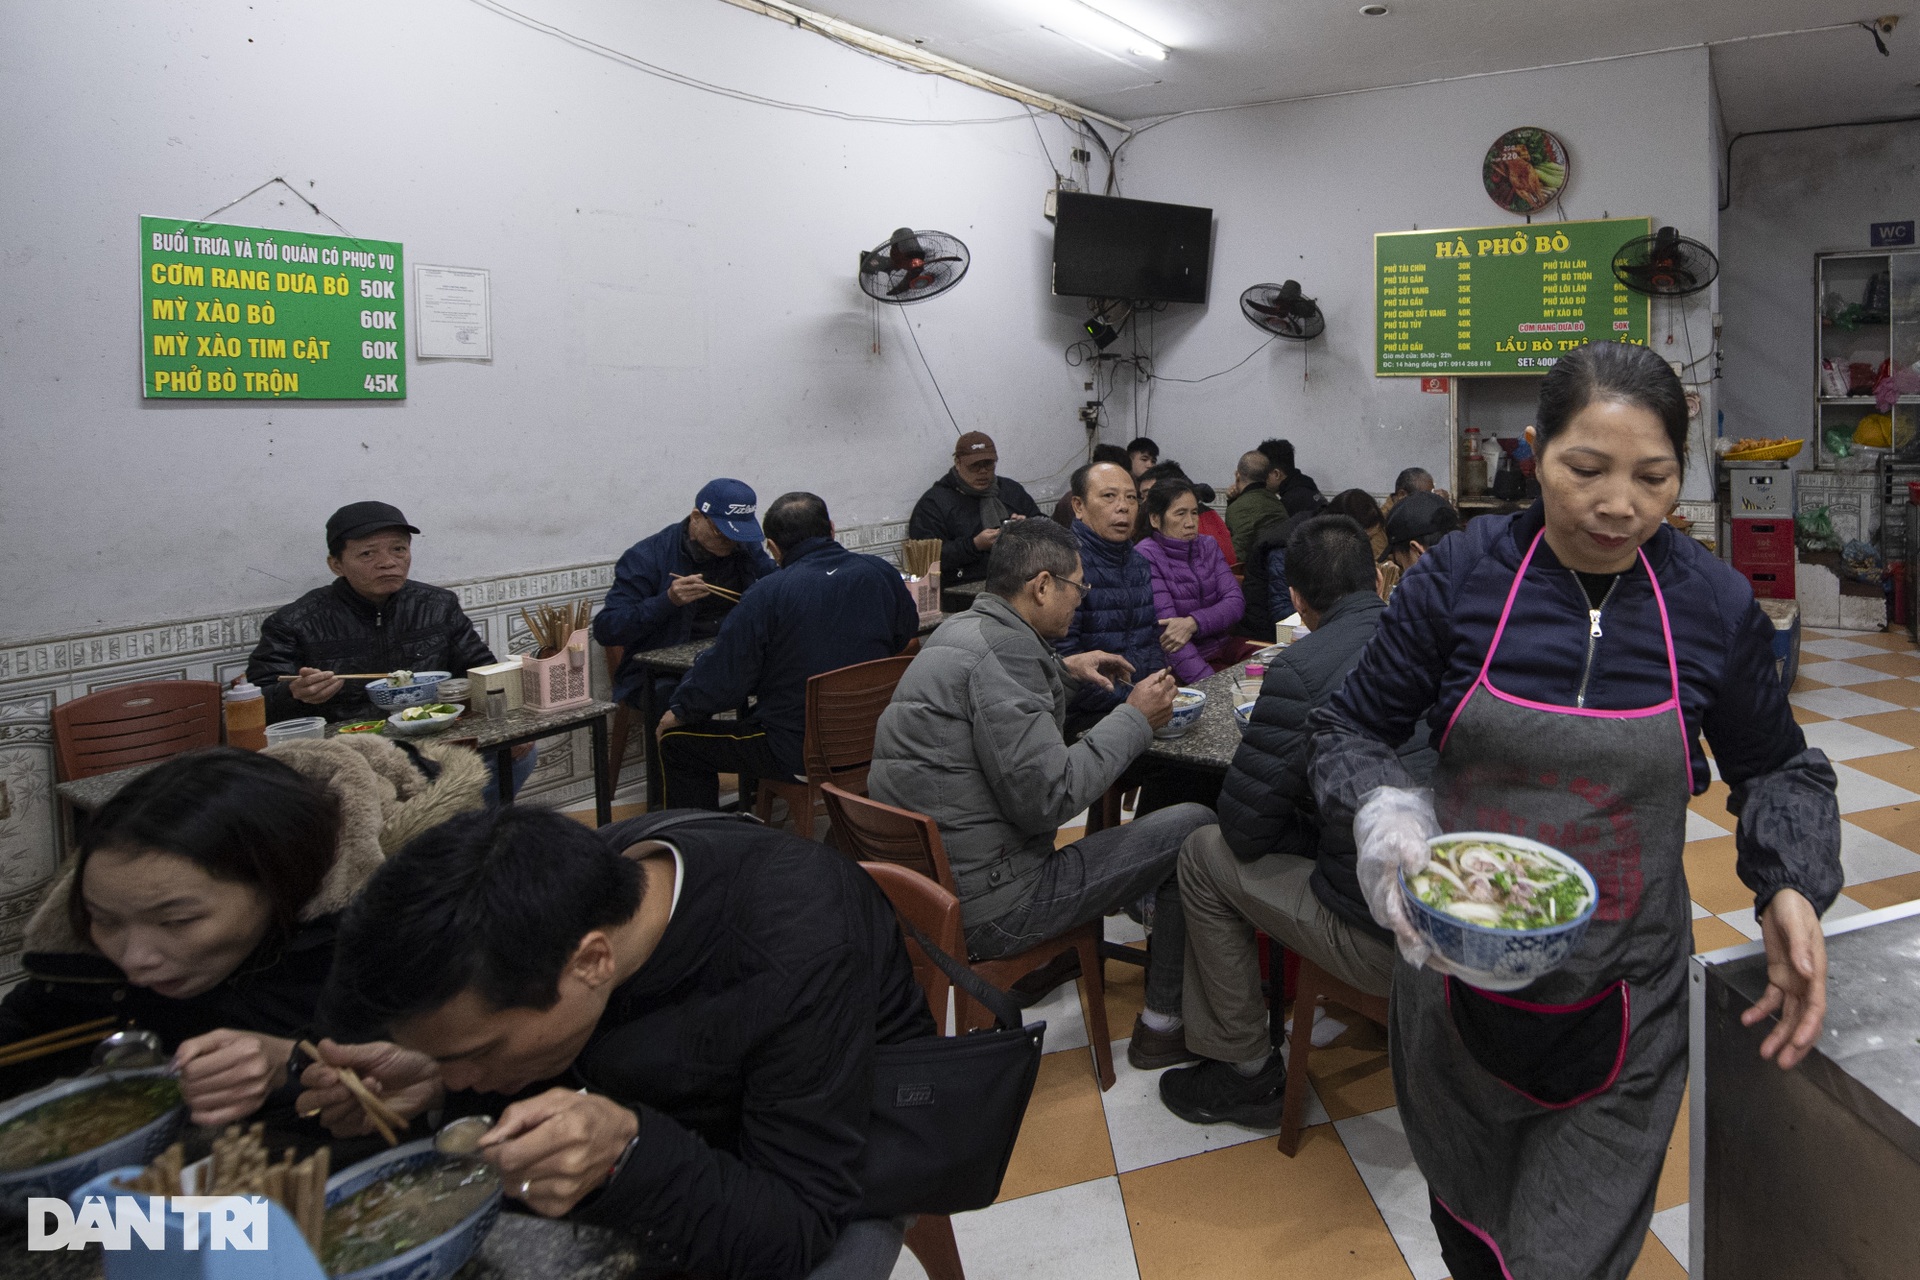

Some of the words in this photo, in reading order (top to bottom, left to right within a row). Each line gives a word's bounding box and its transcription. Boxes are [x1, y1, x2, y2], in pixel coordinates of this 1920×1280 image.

[1880, 226, 1906, 238] WC
[1436, 236, 1471, 258] HÀ
[1477, 231, 1529, 256] PHỞ
[1535, 230, 1571, 254] BÒ
[152, 228, 189, 253] BUỔI
[192, 236, 231, 256] TRƯA
[234, 237, 253, 258] VÀ
[256, 238, 278, 261] TỐI
[281, 246, 318, 264] QUÁN
[322, 246, 338, 266] CÓ
[342, 251, 375, 272] PHỤC
[379, 254, 394, 273] VỤ
[1384, 264, 1397, 273] PHỞ
[1543, 261, 1558, 270] PHỞ
[1560, 261, 1570, 269] TÁI
[151, 263, 204, 286] CƠM
[211, 269, 269, 291] RANG
[276, 272, 318, 294] DƯA
[323, 272, 350, 296] BÒ
[360, 280, 396, 299] 50K
[1384, 276, 1397, 284] PHỞ
[1543, 273, 1558, 281] PHỞ
[1562, 272, 1573, 280] BÒ
[1574, 271, 1592, 281] TRỘN
[1384, 287, 1397, 295] PHỞ
[1458, 285, 1471, 293] 35K
[1543, 284, 1558, 293] PHỞ
[1384, 298, 1397, 307] PHỞ
[1543, 296, 1558, 305] PHỞ
[1560, 296, 1573, 305] XÀO
[1576, 296, 1586, 304] BÒ
[1614, 295, 1628, 303] 60K
[152, 296, 188, 321] MỲ
[196, 297, 240, 324] XÀO
[248, 301, 276, 325] BÒ
[360, 310, 397, 329] 60K
[1384, 310, 1397, 318] PHỞ
[1556, 309, 1571, 317] XÀO
[1614, 307, 1628, 315] 60K
[1384, 321, 1397, 329] PHỞ
[1519, 323, 1535, 333] CƠM
[1537, 323, 1556, 332] RANG
[1558, 323, 1573, 331] DƯA
[1574, 321, 1585, 331] BÒ
[1613, 321, 1629, 330] 50K
[1384, 332, 1397, 340] PHỞ
[1458, 331, 1471, 339] 50K
[153, 331, 189, 356] MỲ
[197, 333, 242, 358] XÀO
[248, 339, 286, 359] TIM
[292, 337, 331, 364] CẬT
[362, 341, 398, 360] 60K
[1384, 343, 1397, 351] PHỞ
[1496, 336, 1527, 352] LẨU
[1532, 338, 1553, 351] BÒ
[1404, 361, 1419, 369] hàng
[1518, 358, 1535, 366] SET:
[155, 366, 202, 392] PHỞ
[208, 367, 237, 392] BÒ
[243, 371, 299, 396] TRỘN
[364, 374, 398, 393] 45K
